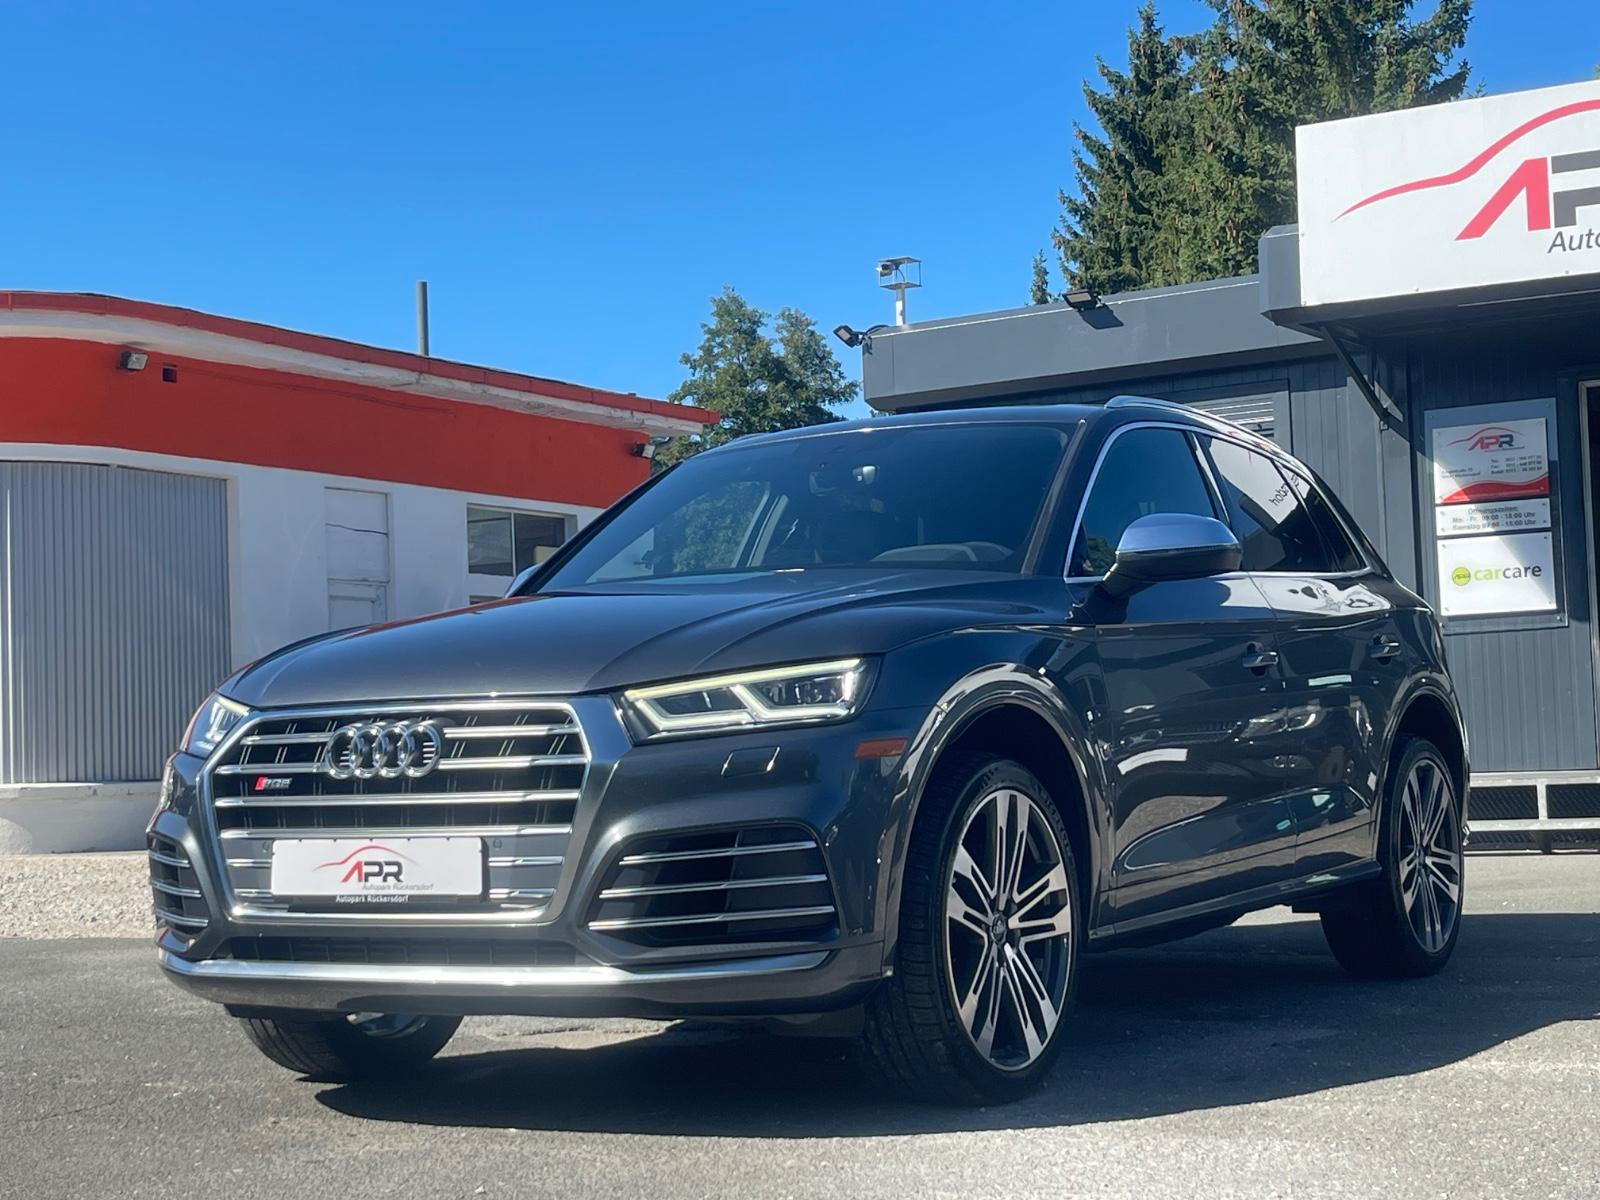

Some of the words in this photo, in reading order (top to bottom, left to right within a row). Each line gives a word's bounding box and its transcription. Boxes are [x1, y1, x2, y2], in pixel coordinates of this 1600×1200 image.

[1468, 434, 1514, 451] APR
[1524, 518, 1537, 526] Uhr
[341, 860, 404, 883] APR
[335, 894, 366, 904] Autopark
